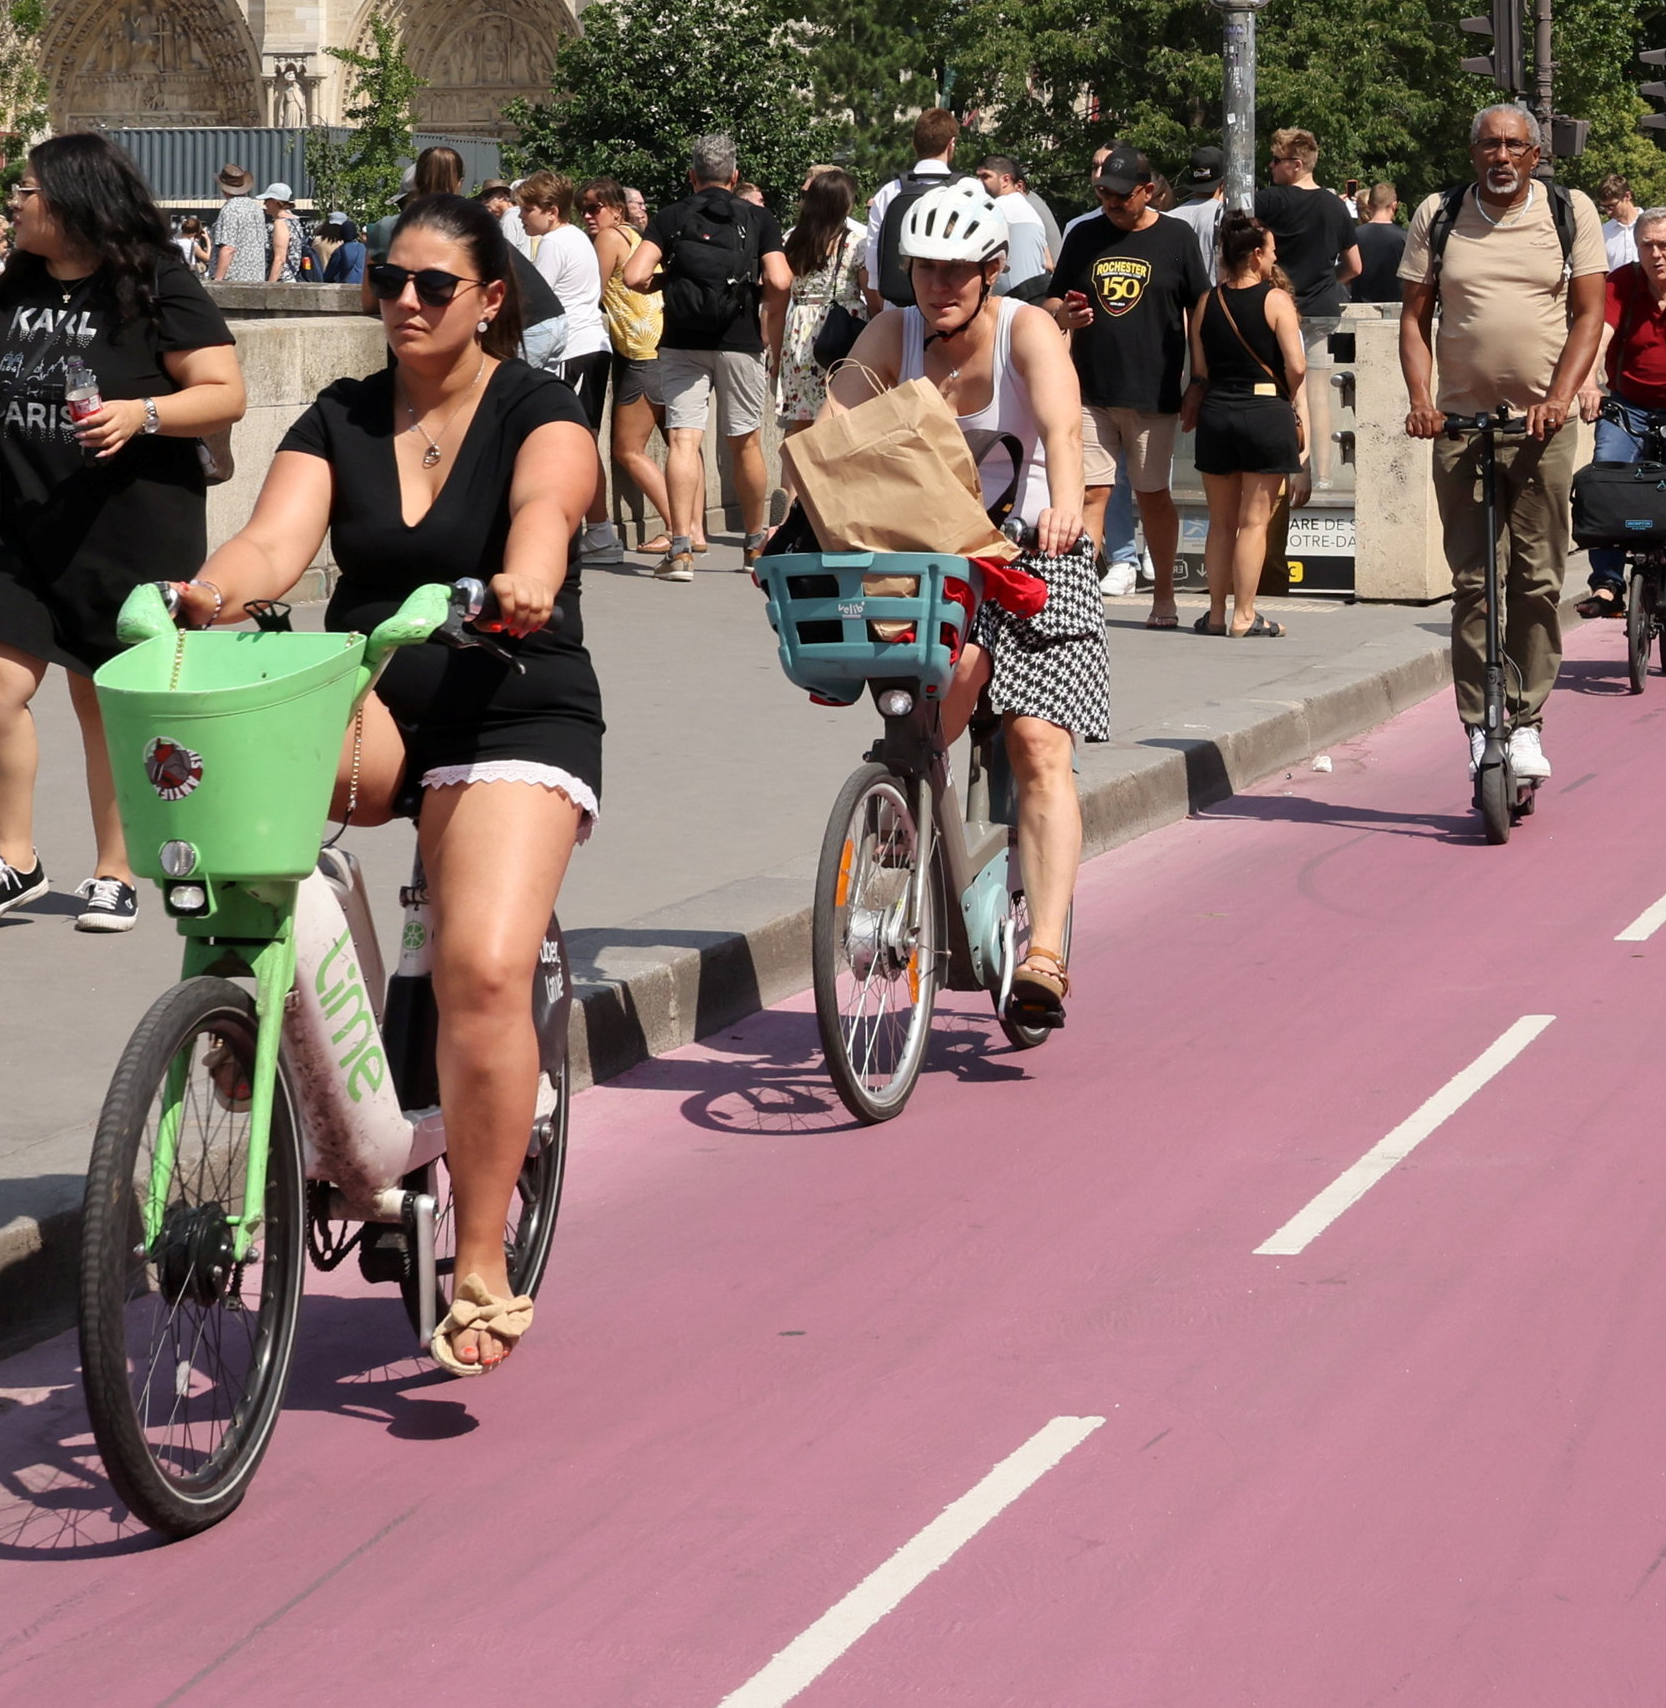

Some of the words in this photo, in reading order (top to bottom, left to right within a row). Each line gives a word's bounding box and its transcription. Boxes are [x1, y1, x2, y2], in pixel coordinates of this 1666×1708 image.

[1096, 261, 1147, 278] ROCHESTER
[1101, 276, 1140, 301] 150
[7, 305, 97, 345] KARL
[1324, 518, 1345, 531] DE
[315, 926, 384, 1104] Lime
